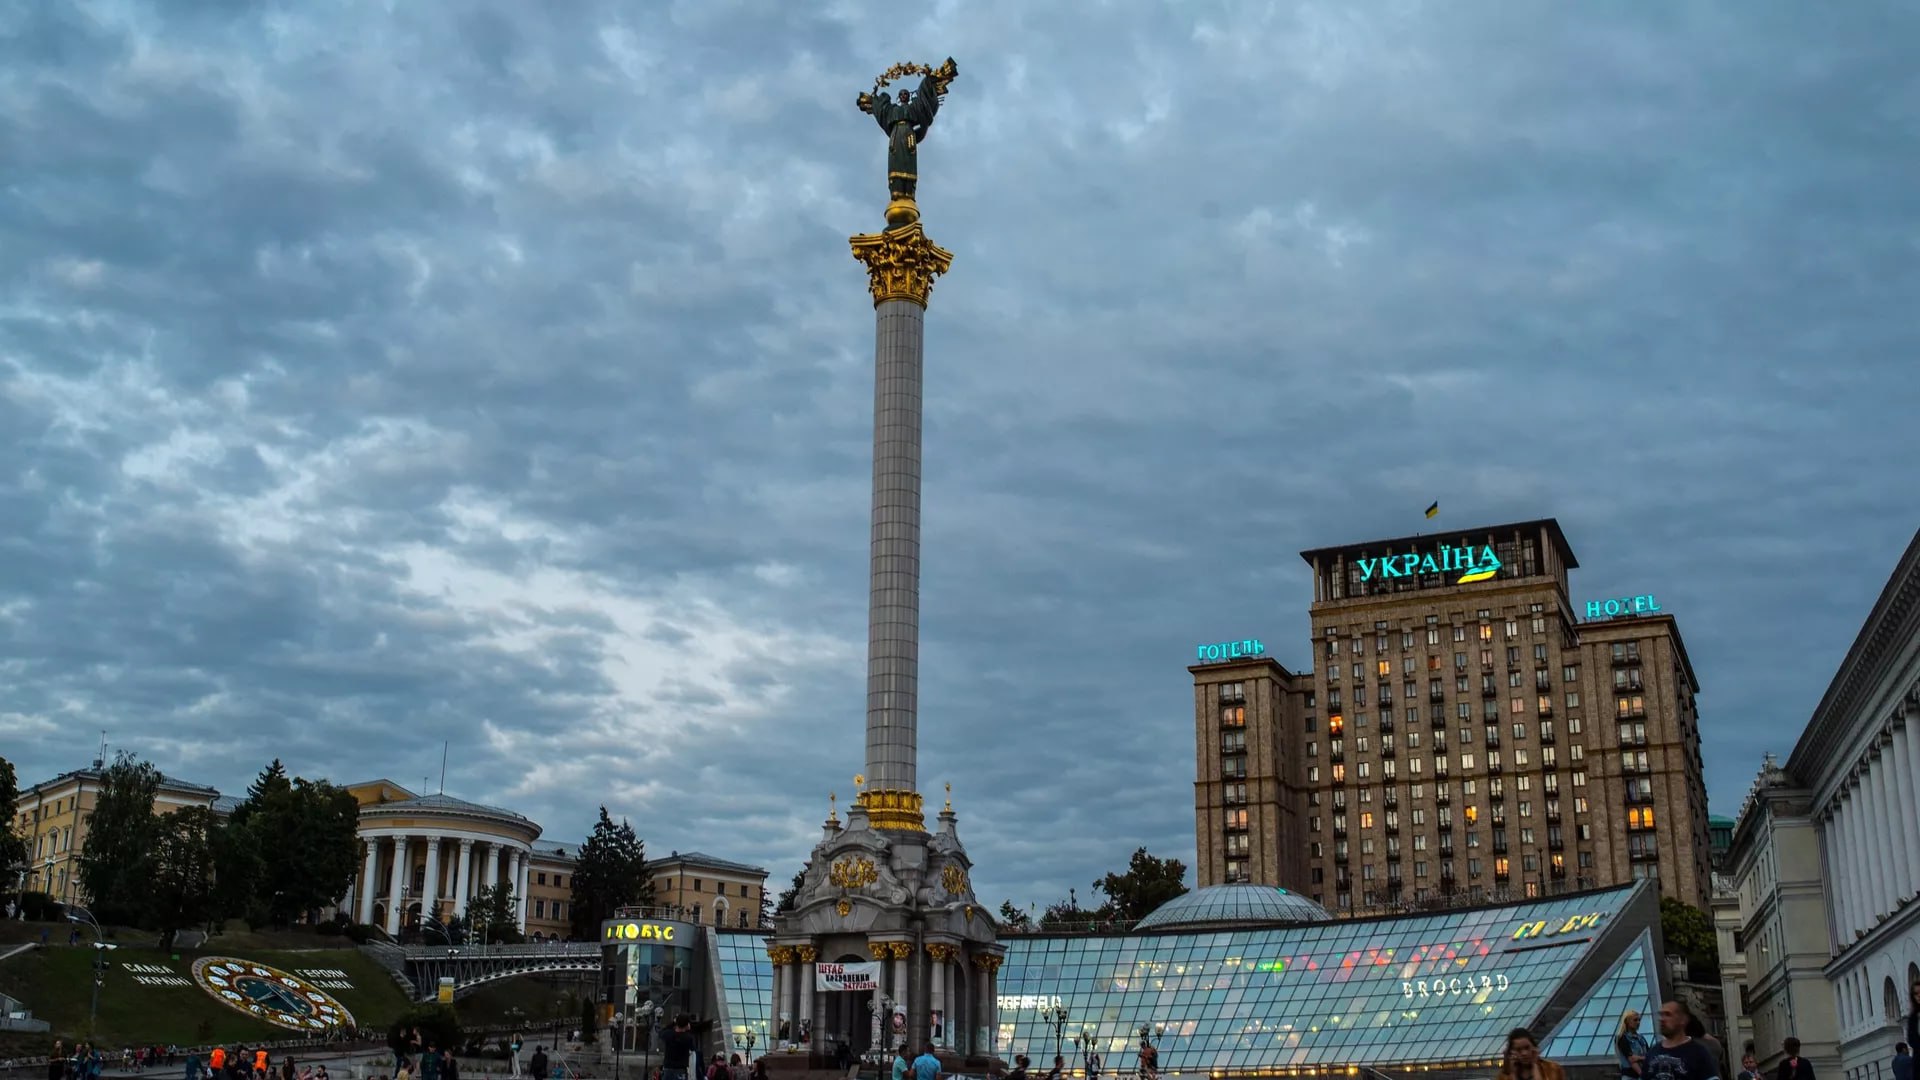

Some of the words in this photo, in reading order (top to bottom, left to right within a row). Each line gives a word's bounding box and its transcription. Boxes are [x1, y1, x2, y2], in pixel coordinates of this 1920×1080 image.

[1357, 544, 1501, 582] УКРАЇНА
[1586, 595, 1661, 617] HOTEL
[1198, 639, 1264, 659] ГОТЕЛЬ
[121, 962, 175, 973] СЛАВА
[818, 963, 844, 974] ШТАБ
[1402, 974, 1509, 999] BROCARD
